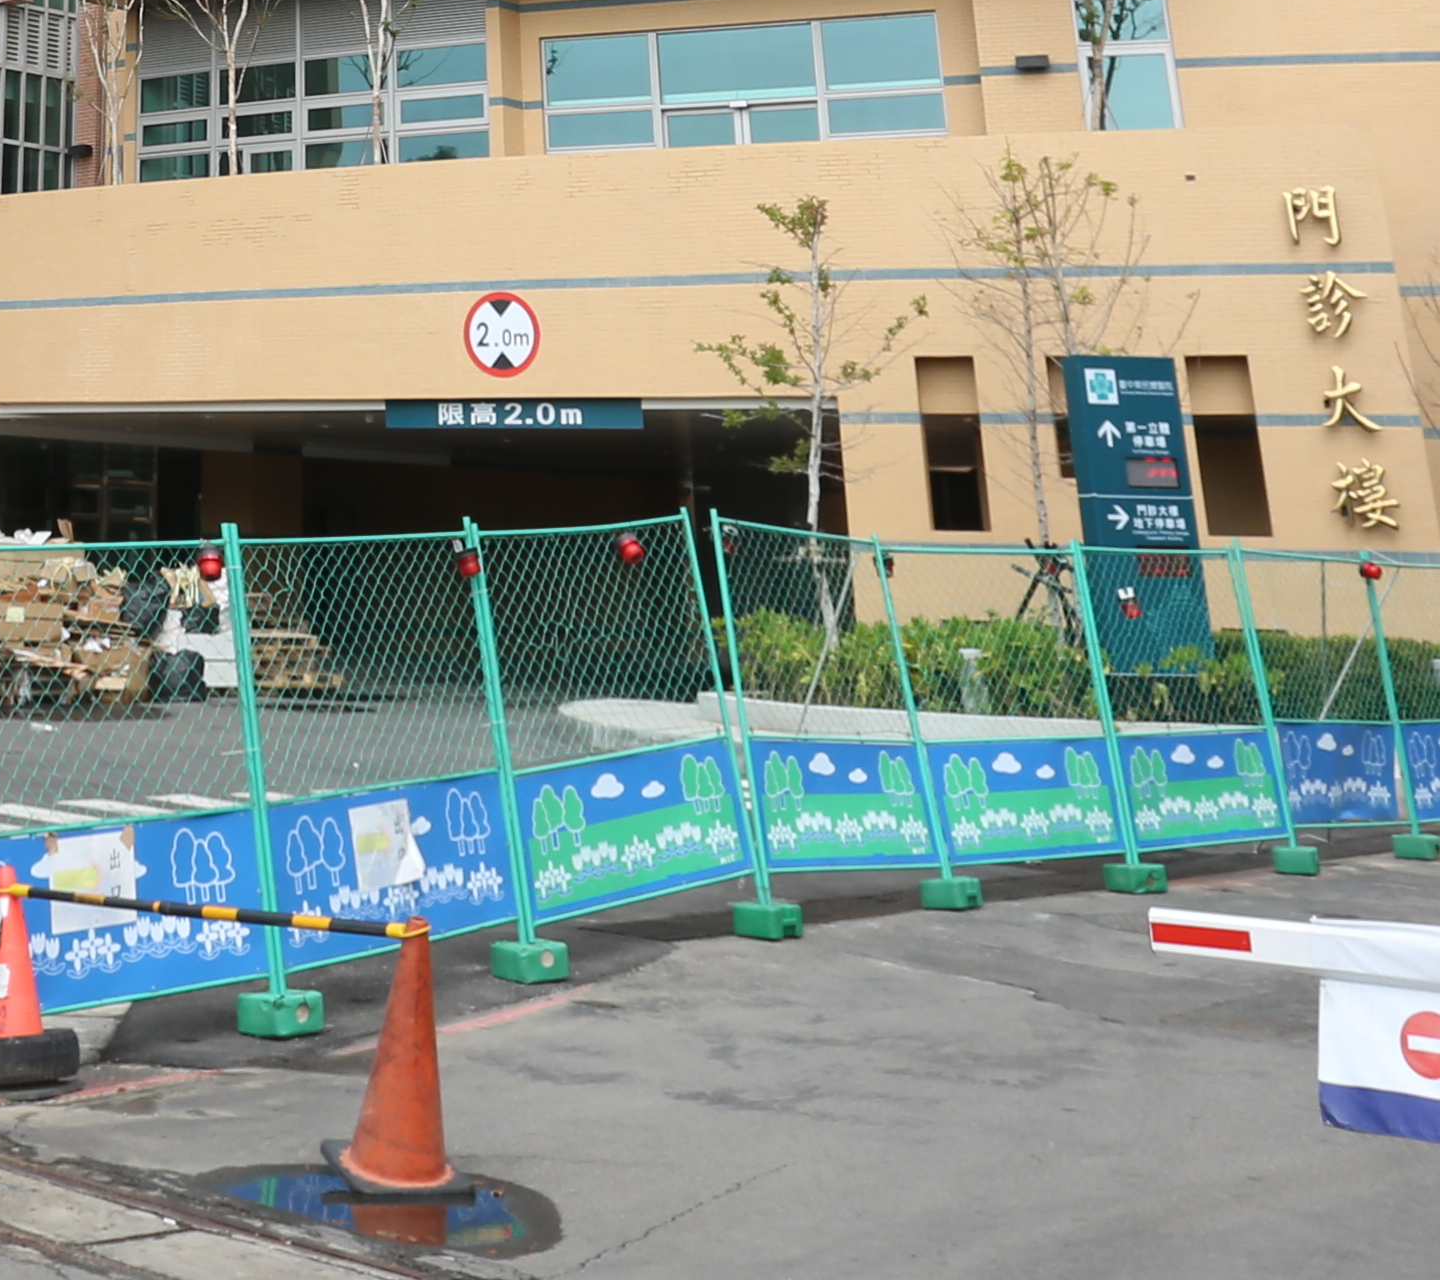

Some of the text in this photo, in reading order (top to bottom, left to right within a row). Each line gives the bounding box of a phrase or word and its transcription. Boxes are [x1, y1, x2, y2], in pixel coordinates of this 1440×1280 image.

[476, 321, 530, 347] 2.0m
[1282, 185, 1400, 530] 門診大樓
[1136, 504, 1180, 517] 門診大樓
[1132, 518, 1187, 530] 地下停車場
